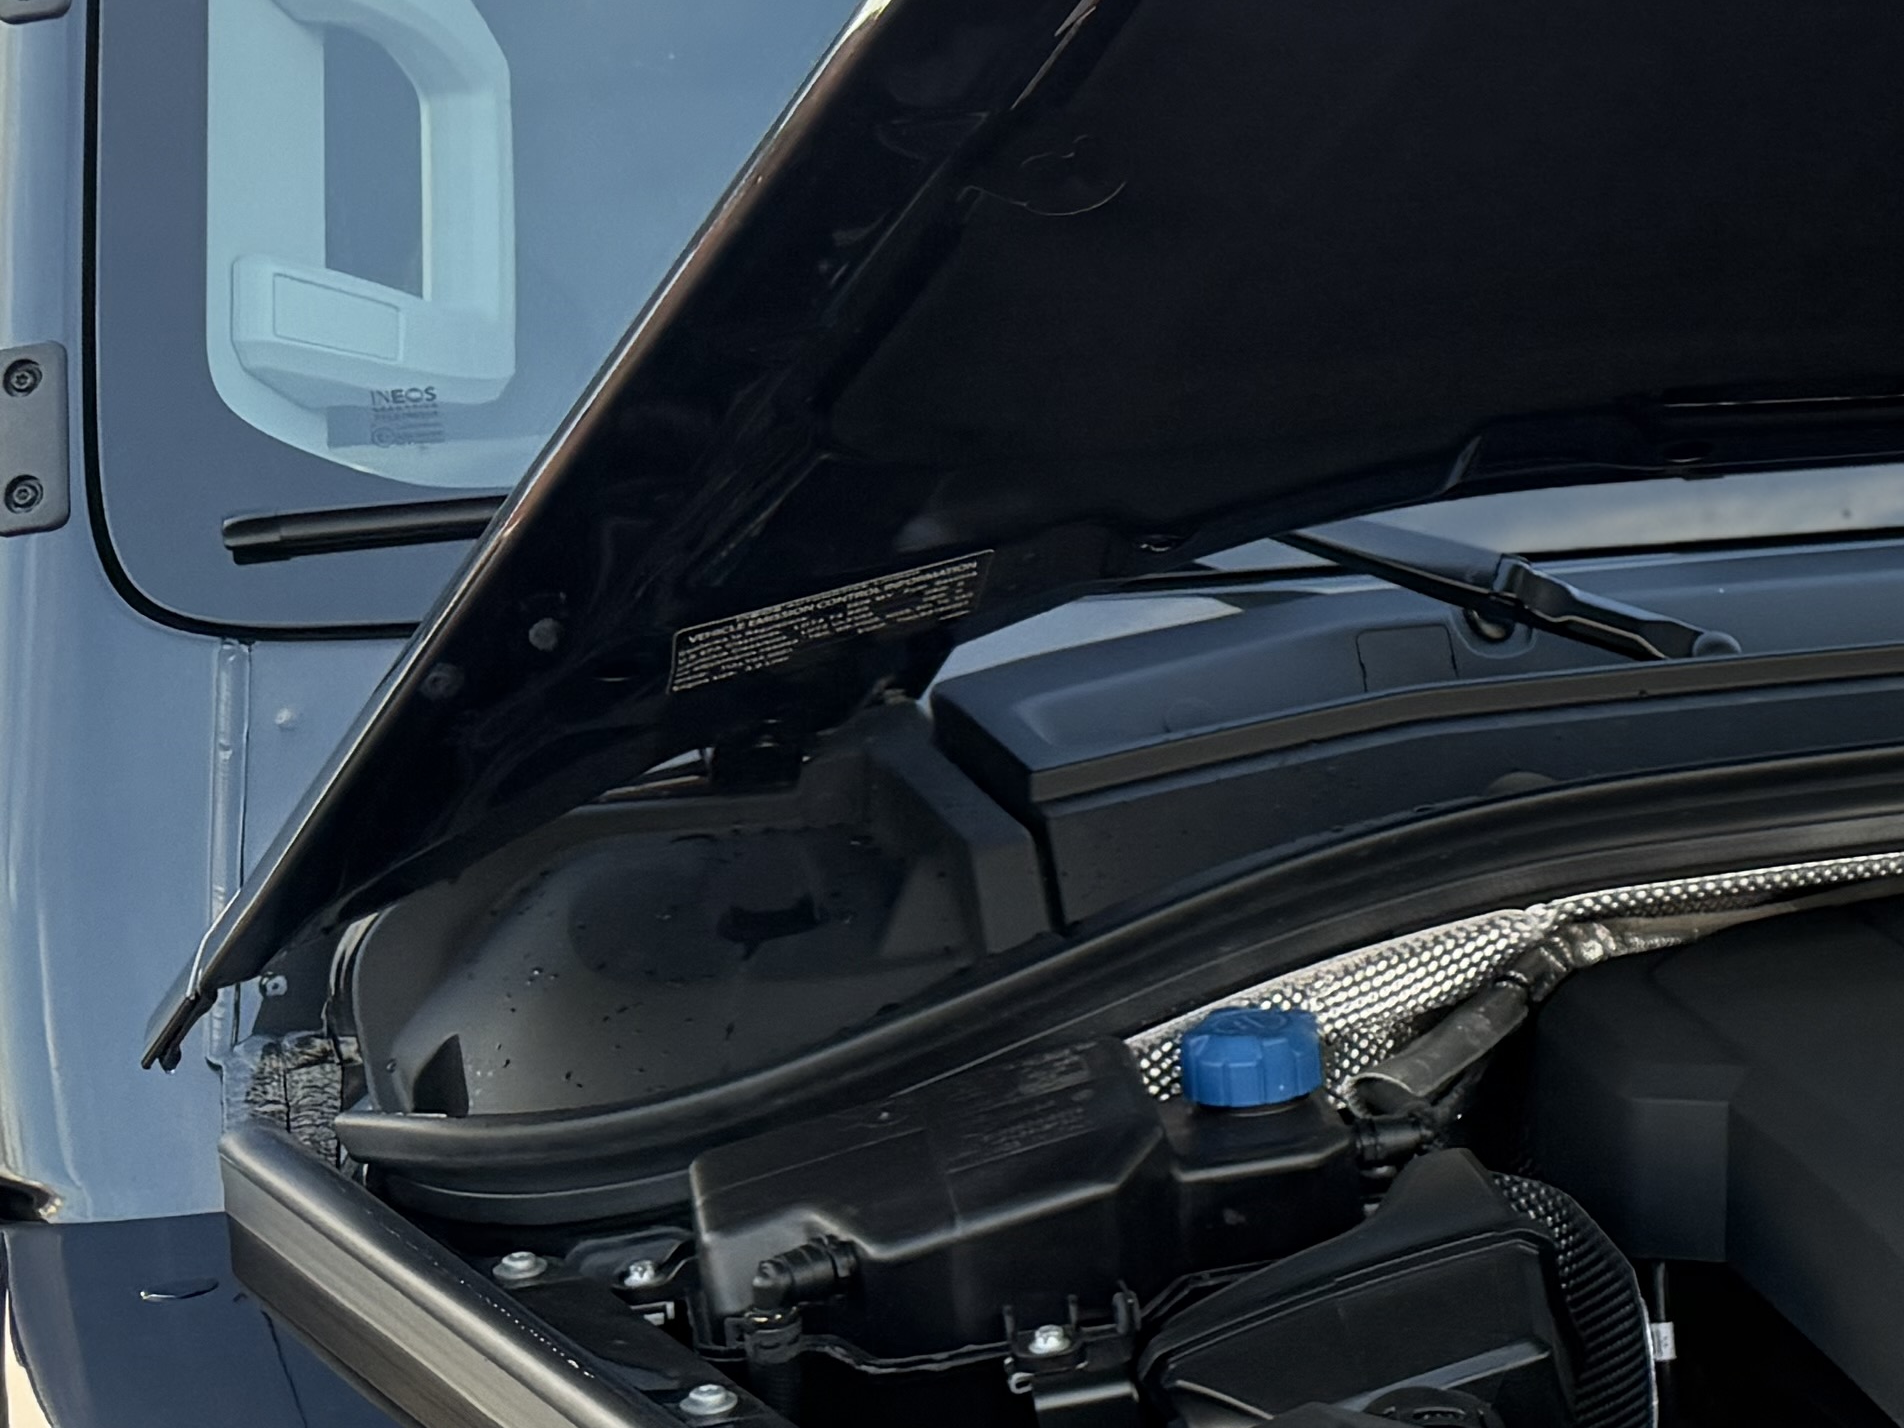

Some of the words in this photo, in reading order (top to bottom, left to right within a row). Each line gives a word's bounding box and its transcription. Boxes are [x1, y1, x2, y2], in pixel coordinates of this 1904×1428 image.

[370, 385, 437, 405] INEOS
[688, 619, 747, 644] VEHICLE
[749, 603, 814, 628] EMISSION
[815, 586, 881, 610] CONTROL
[883, 561, 978, 593] INFORMATION
